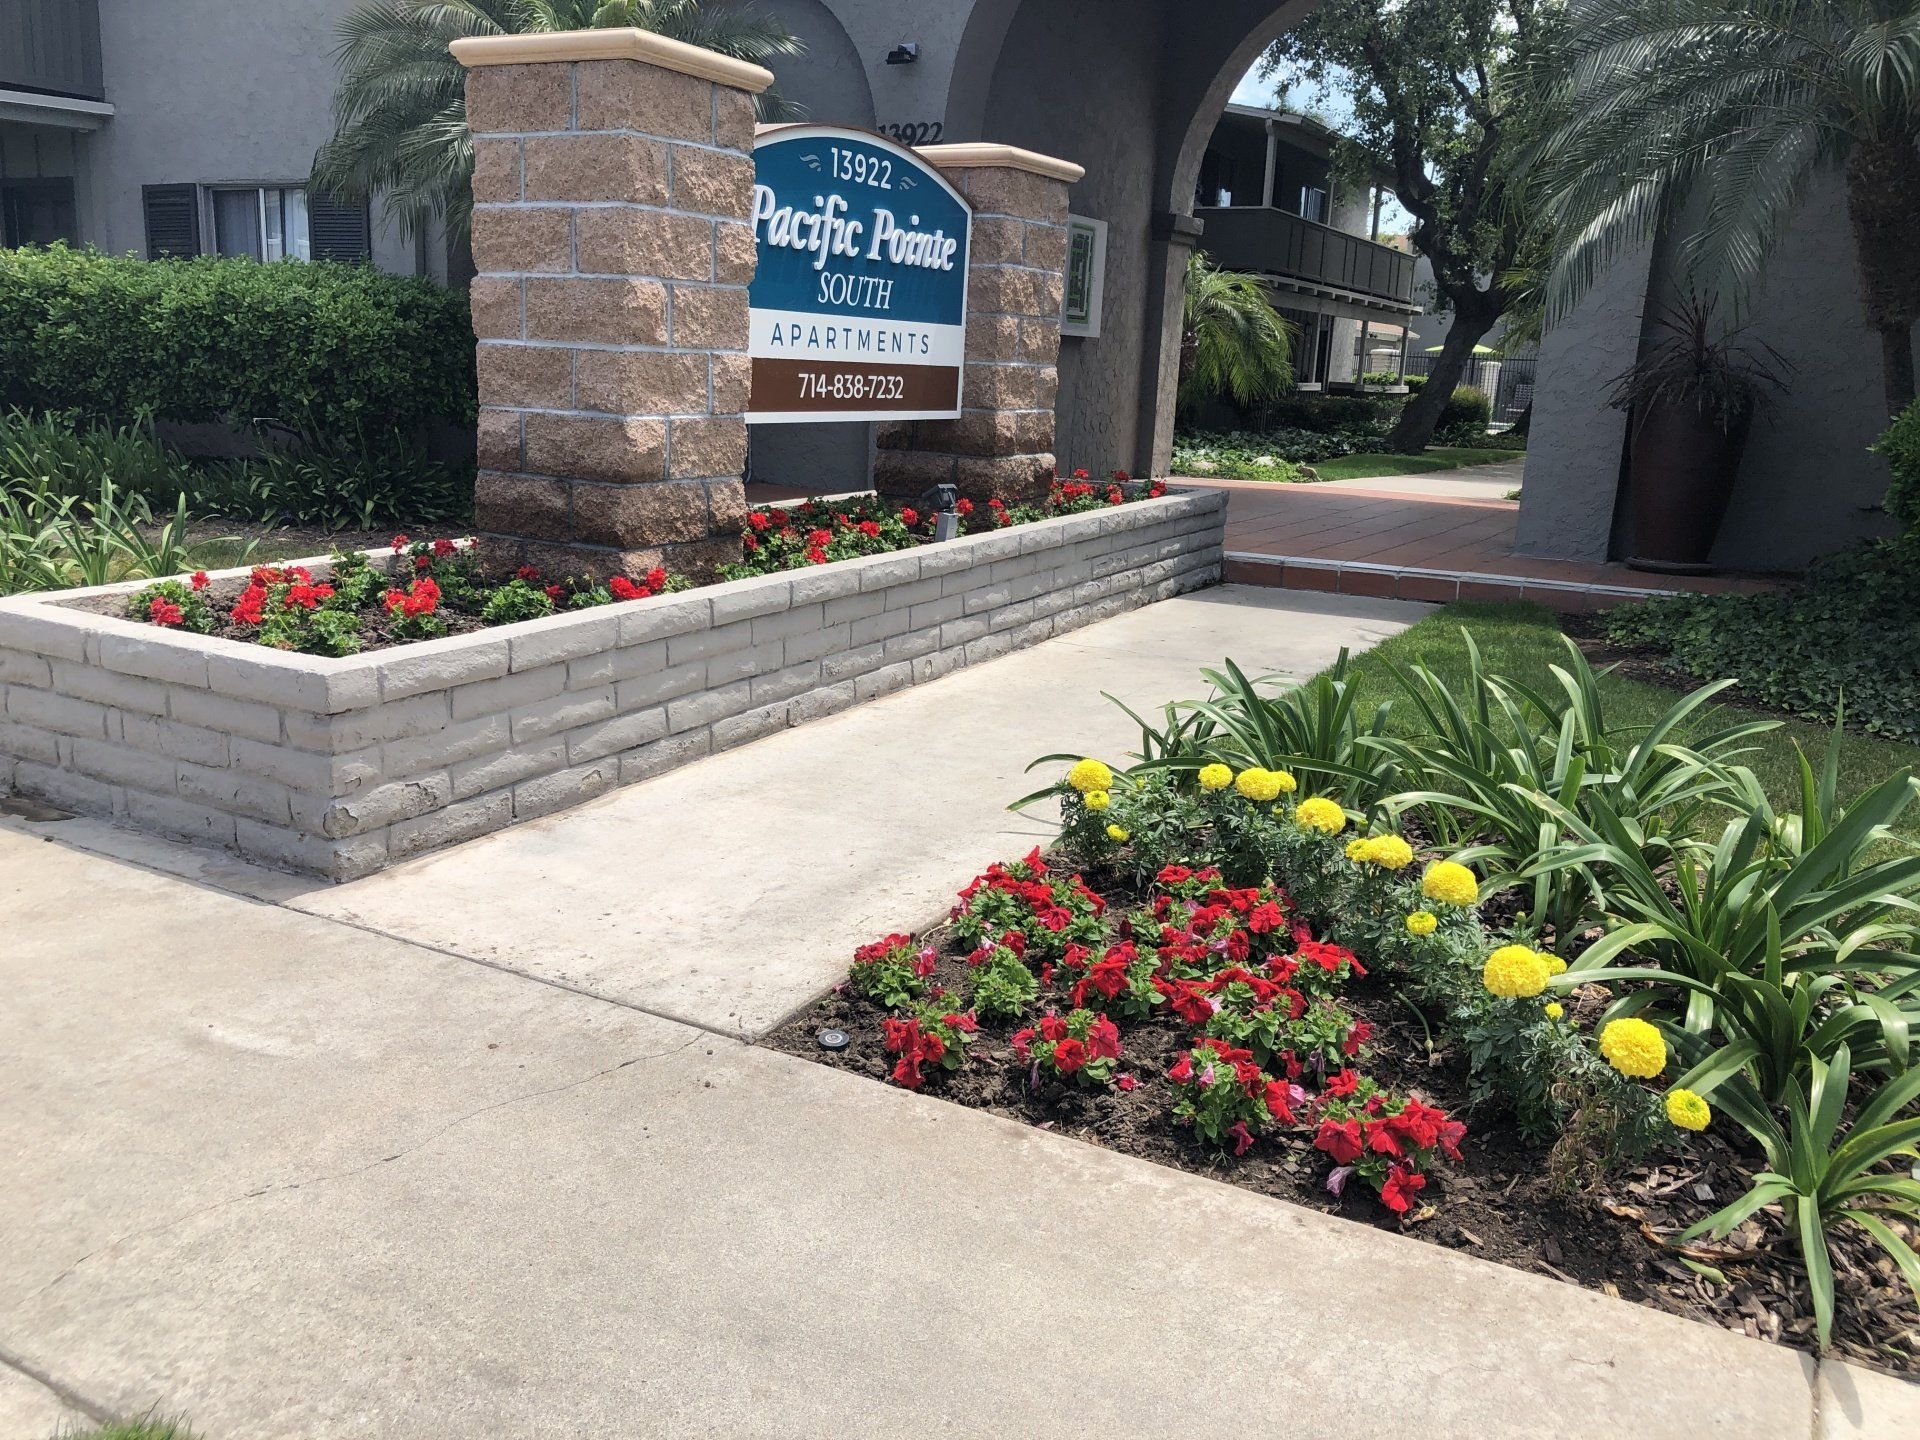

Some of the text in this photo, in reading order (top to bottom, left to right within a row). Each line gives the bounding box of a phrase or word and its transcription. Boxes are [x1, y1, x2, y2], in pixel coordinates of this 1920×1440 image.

[831, 147, 892, 190] 13922
[754, 184, 957, 271] Pacific Pointe
[818, 271, 894, 310] SOUTH
[771, 322, 929, 354] APARTMENTS
[798, 373, 904, 399] 714-838-7232
